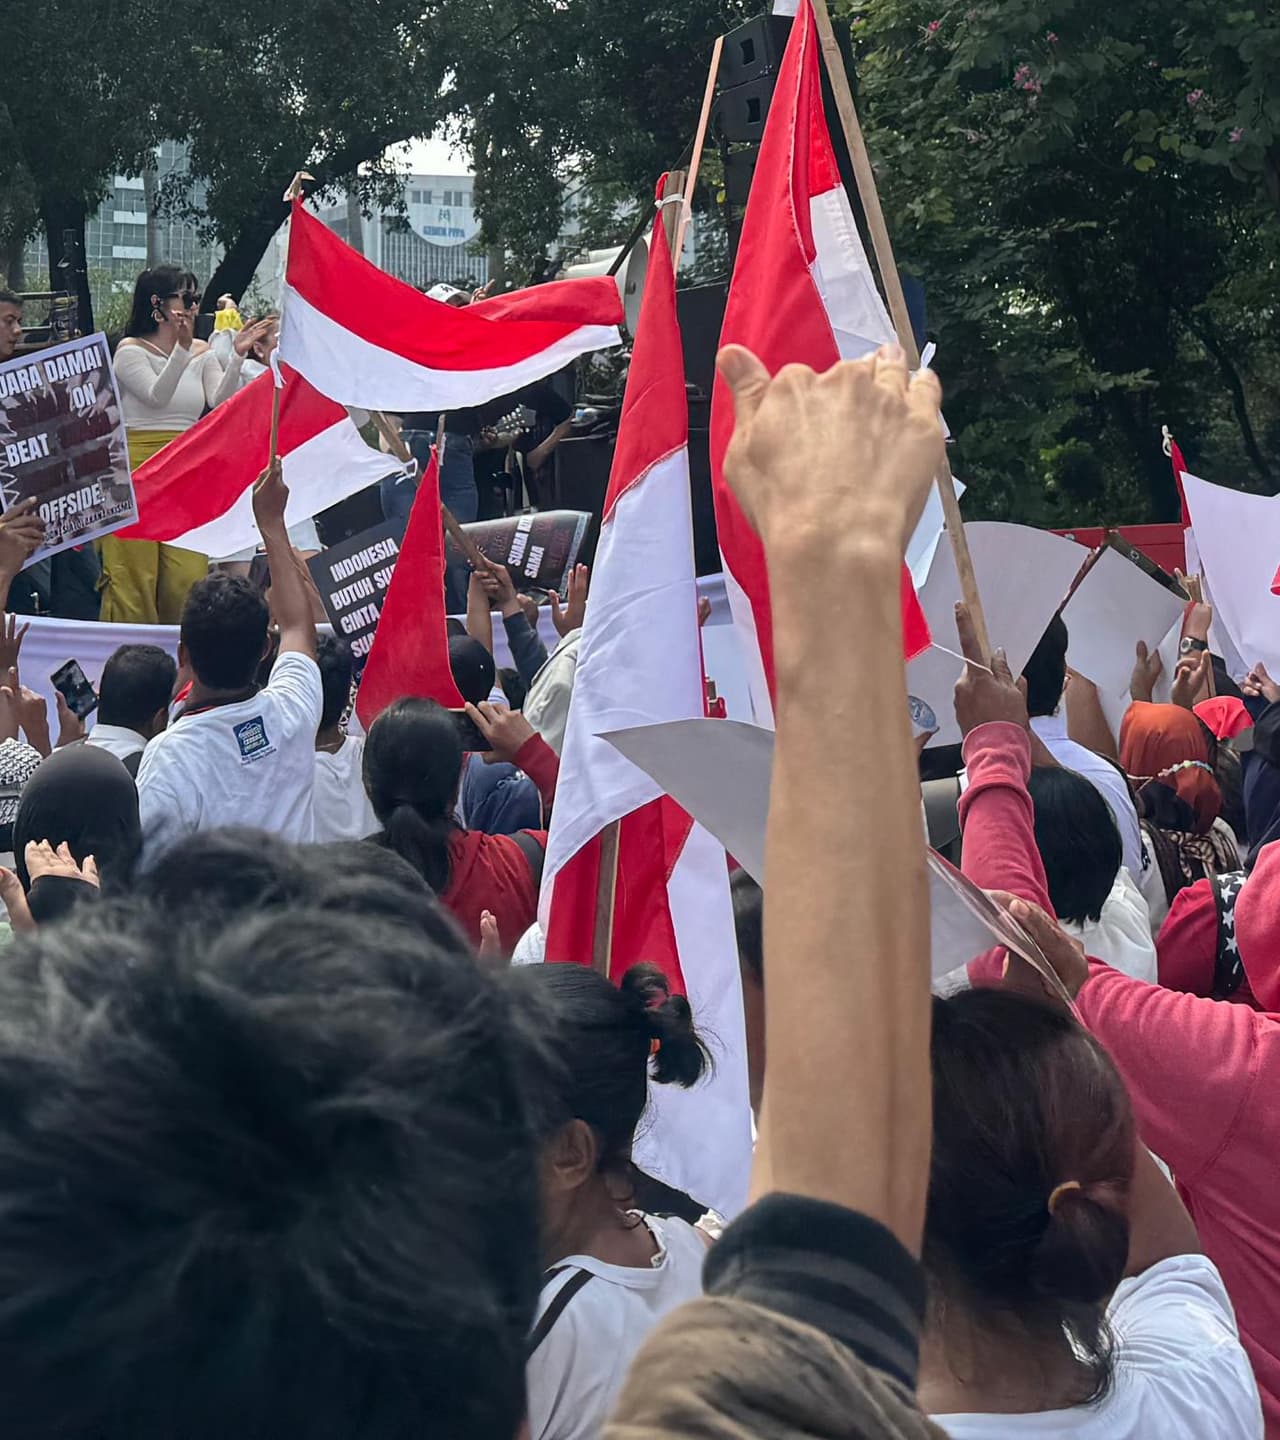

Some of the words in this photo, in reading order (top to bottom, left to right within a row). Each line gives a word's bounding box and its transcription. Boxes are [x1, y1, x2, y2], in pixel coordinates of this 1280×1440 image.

[44, 345, 103, 383] DAMAI
[73, 383, 97, 411] ON
[5, 432, 50, 468] BEAT
[329, 537, 400, 583] INDONESIA
[507, 531, 529, 567] SUARA
[524, 545, 545, 578] SAMA
[329, 576, 375, 611] BUTUH
[340, 602, 381, 635] CINTA
